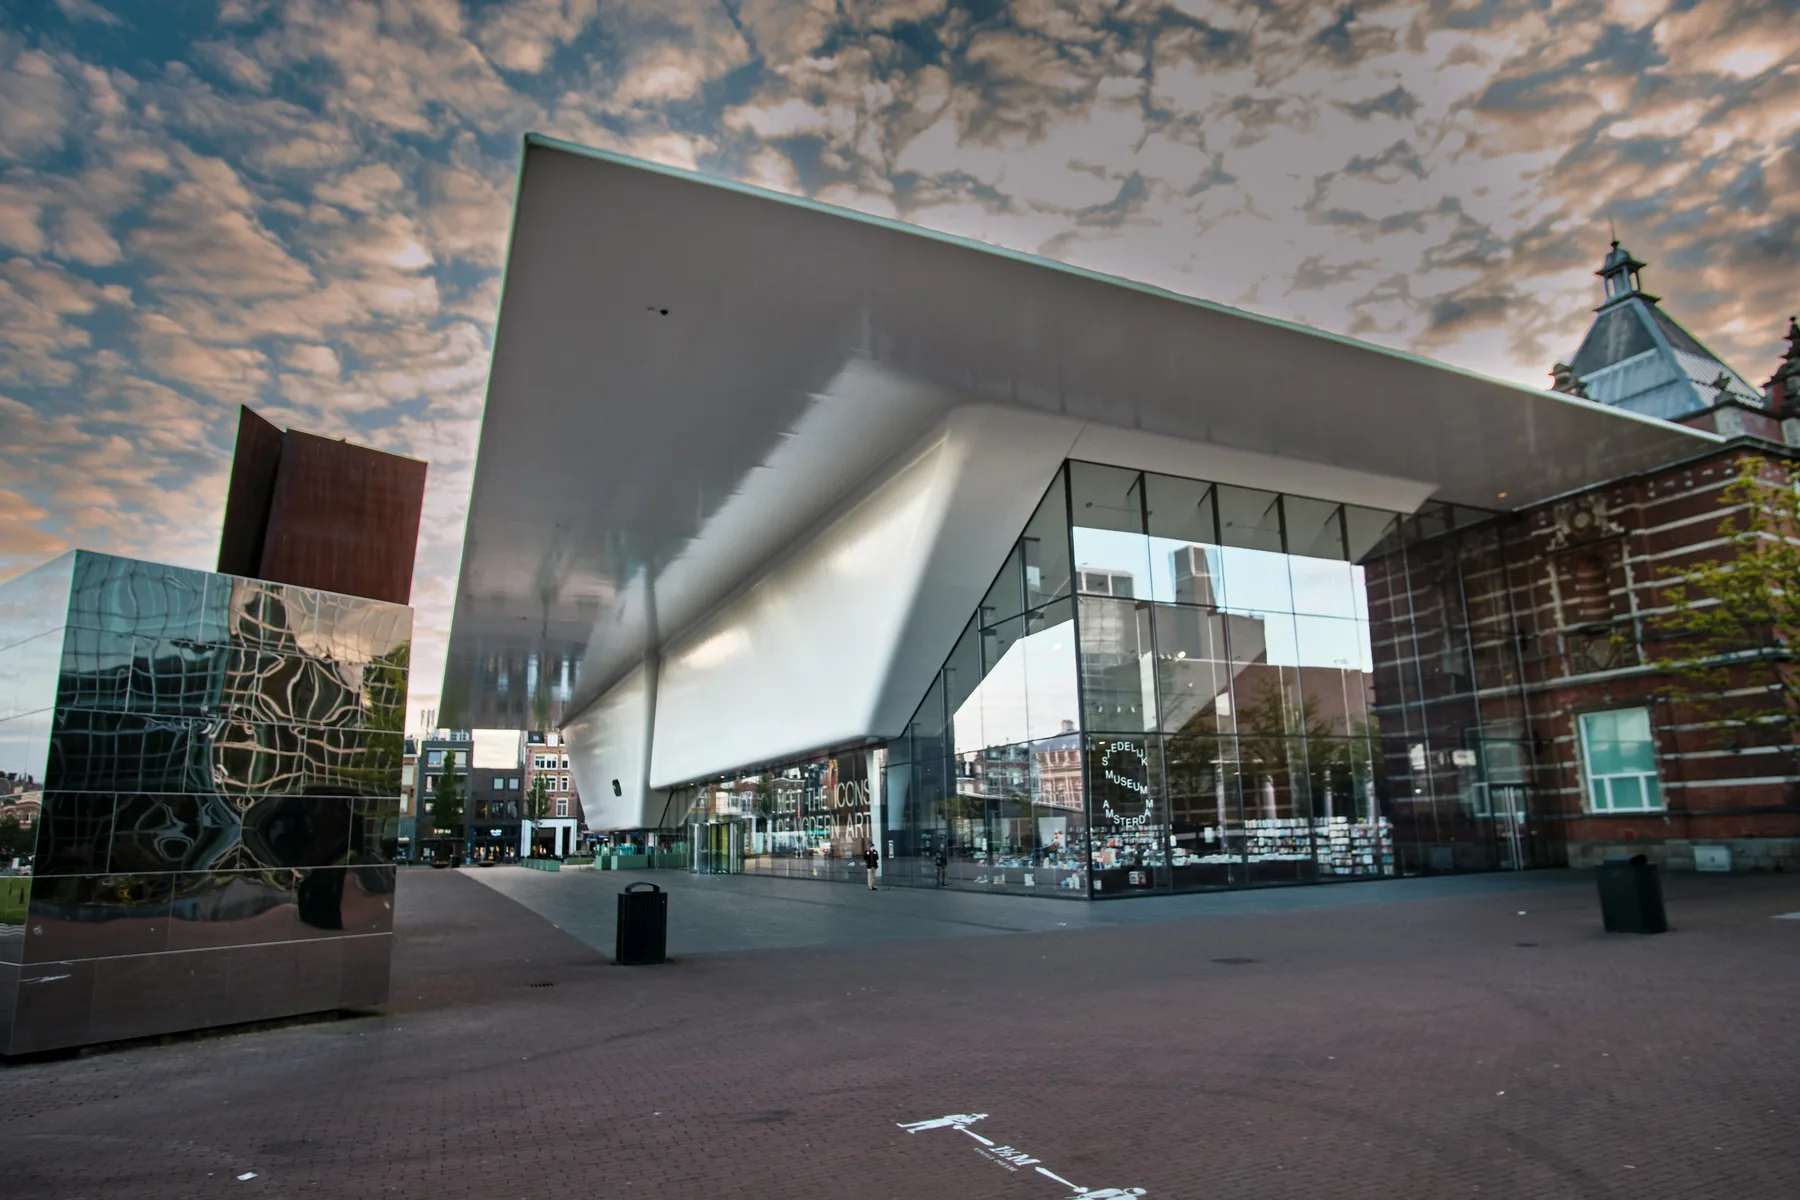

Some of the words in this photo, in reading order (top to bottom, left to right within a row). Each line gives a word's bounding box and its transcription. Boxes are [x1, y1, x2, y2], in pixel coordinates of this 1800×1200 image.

[777, 789, 802, 814] MEET
[806, 785, 828, 811] THE
[834, 779, 870, 808] ICONS
[1105, 770, 1148, 794] MUSEUM
[845, 811, 872, 841] ART
[1102, 799, 1154, 828] AMSTERDAM
